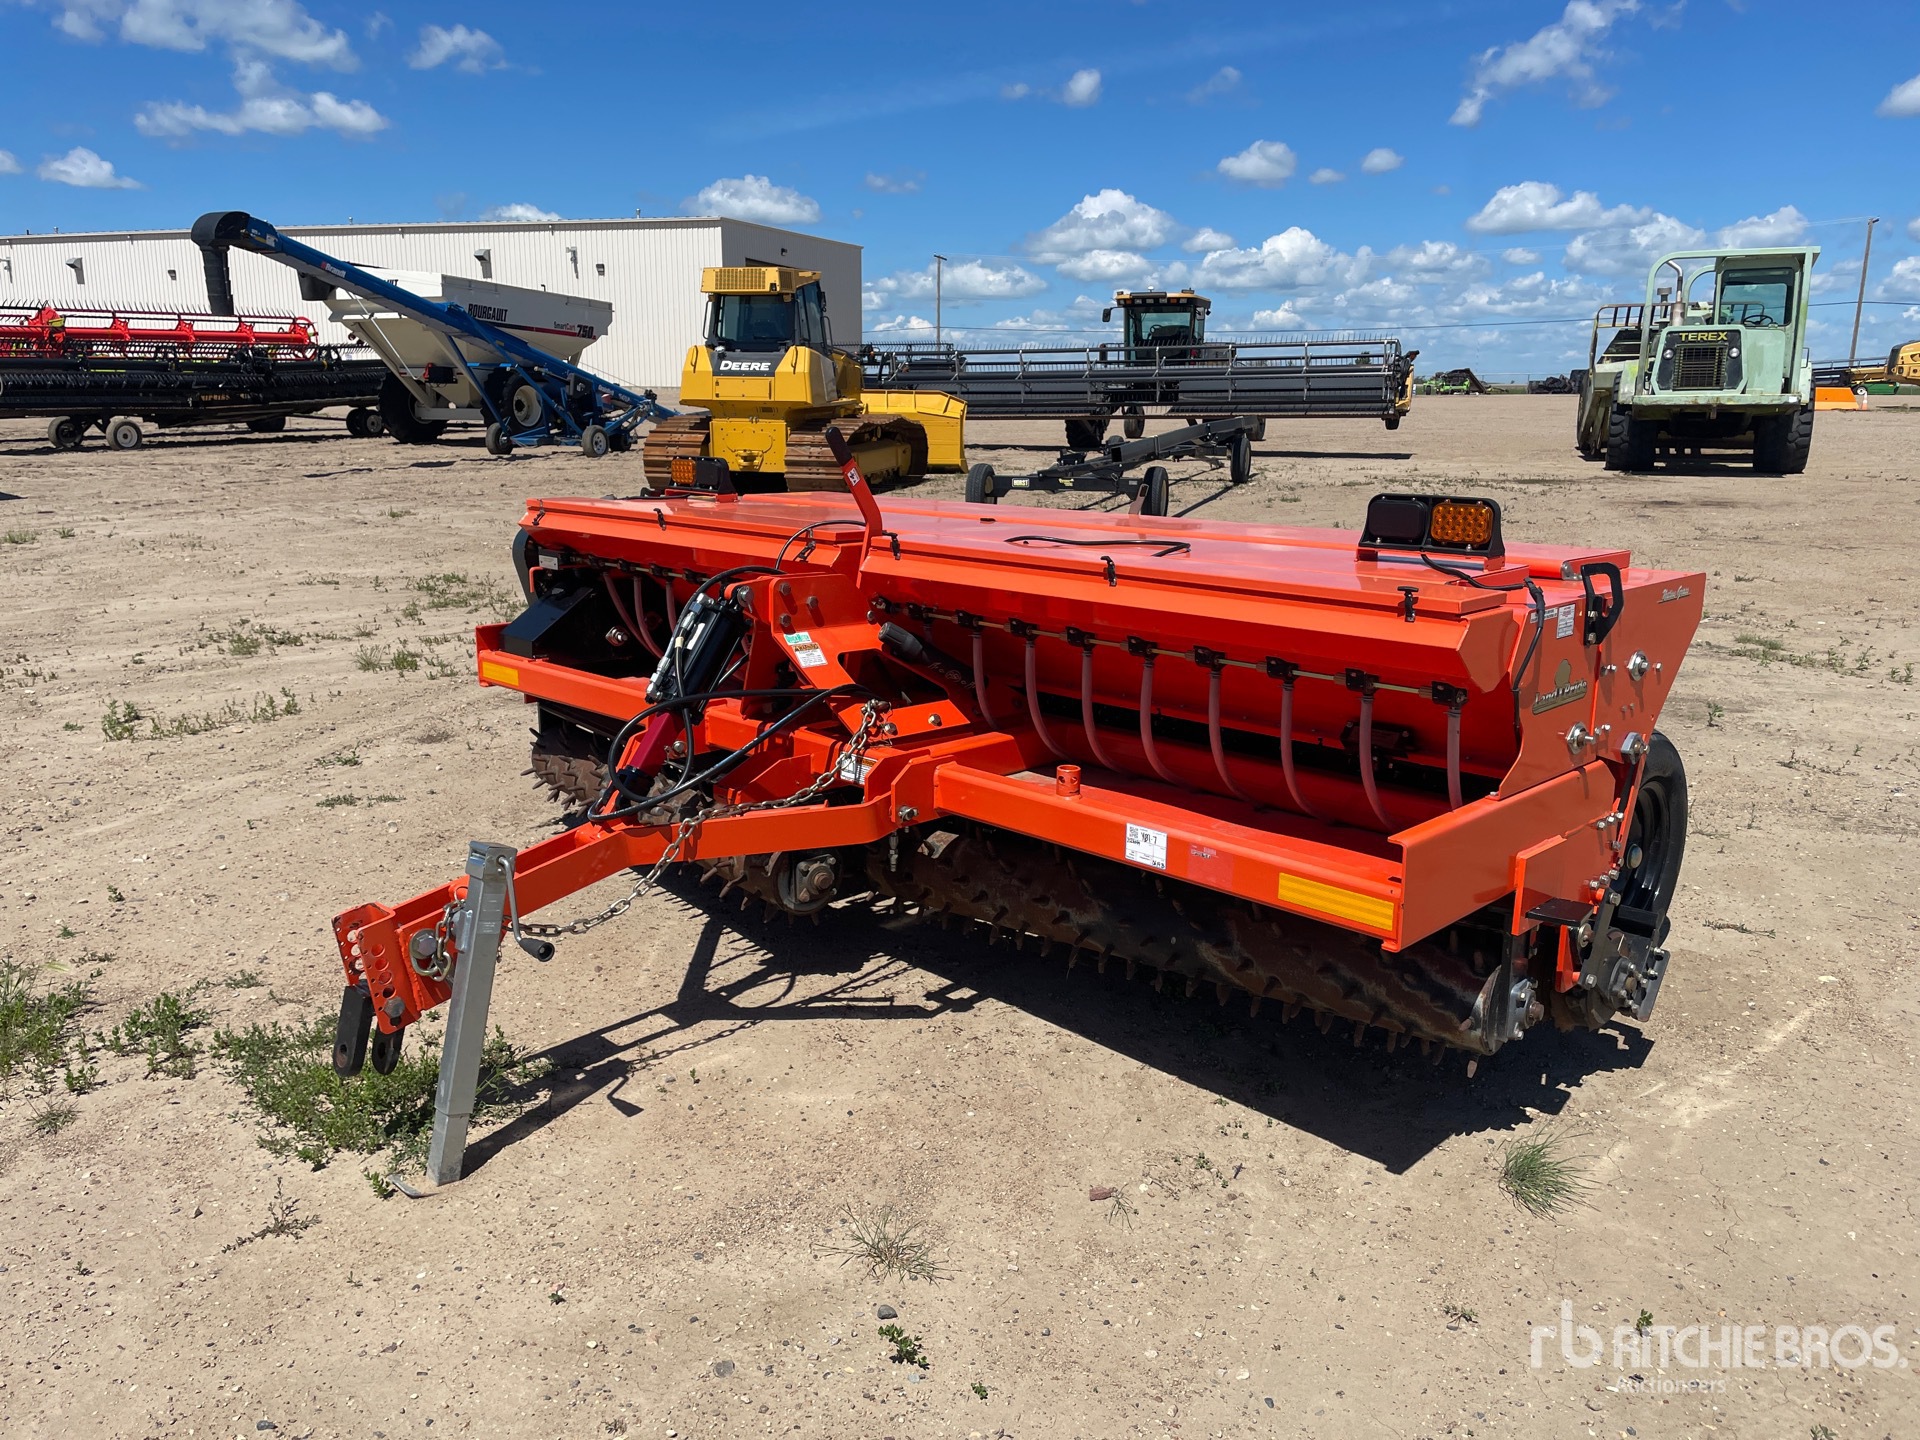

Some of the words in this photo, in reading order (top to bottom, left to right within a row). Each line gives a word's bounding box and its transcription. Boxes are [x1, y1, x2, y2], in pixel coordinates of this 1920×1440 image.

[467, 303, 508, 322] BOURGAULT
[576, 324, 595, 339] 750
[1678, 331, 1728, 342] TEREX
[720, 360, 772, 371] DEERE
